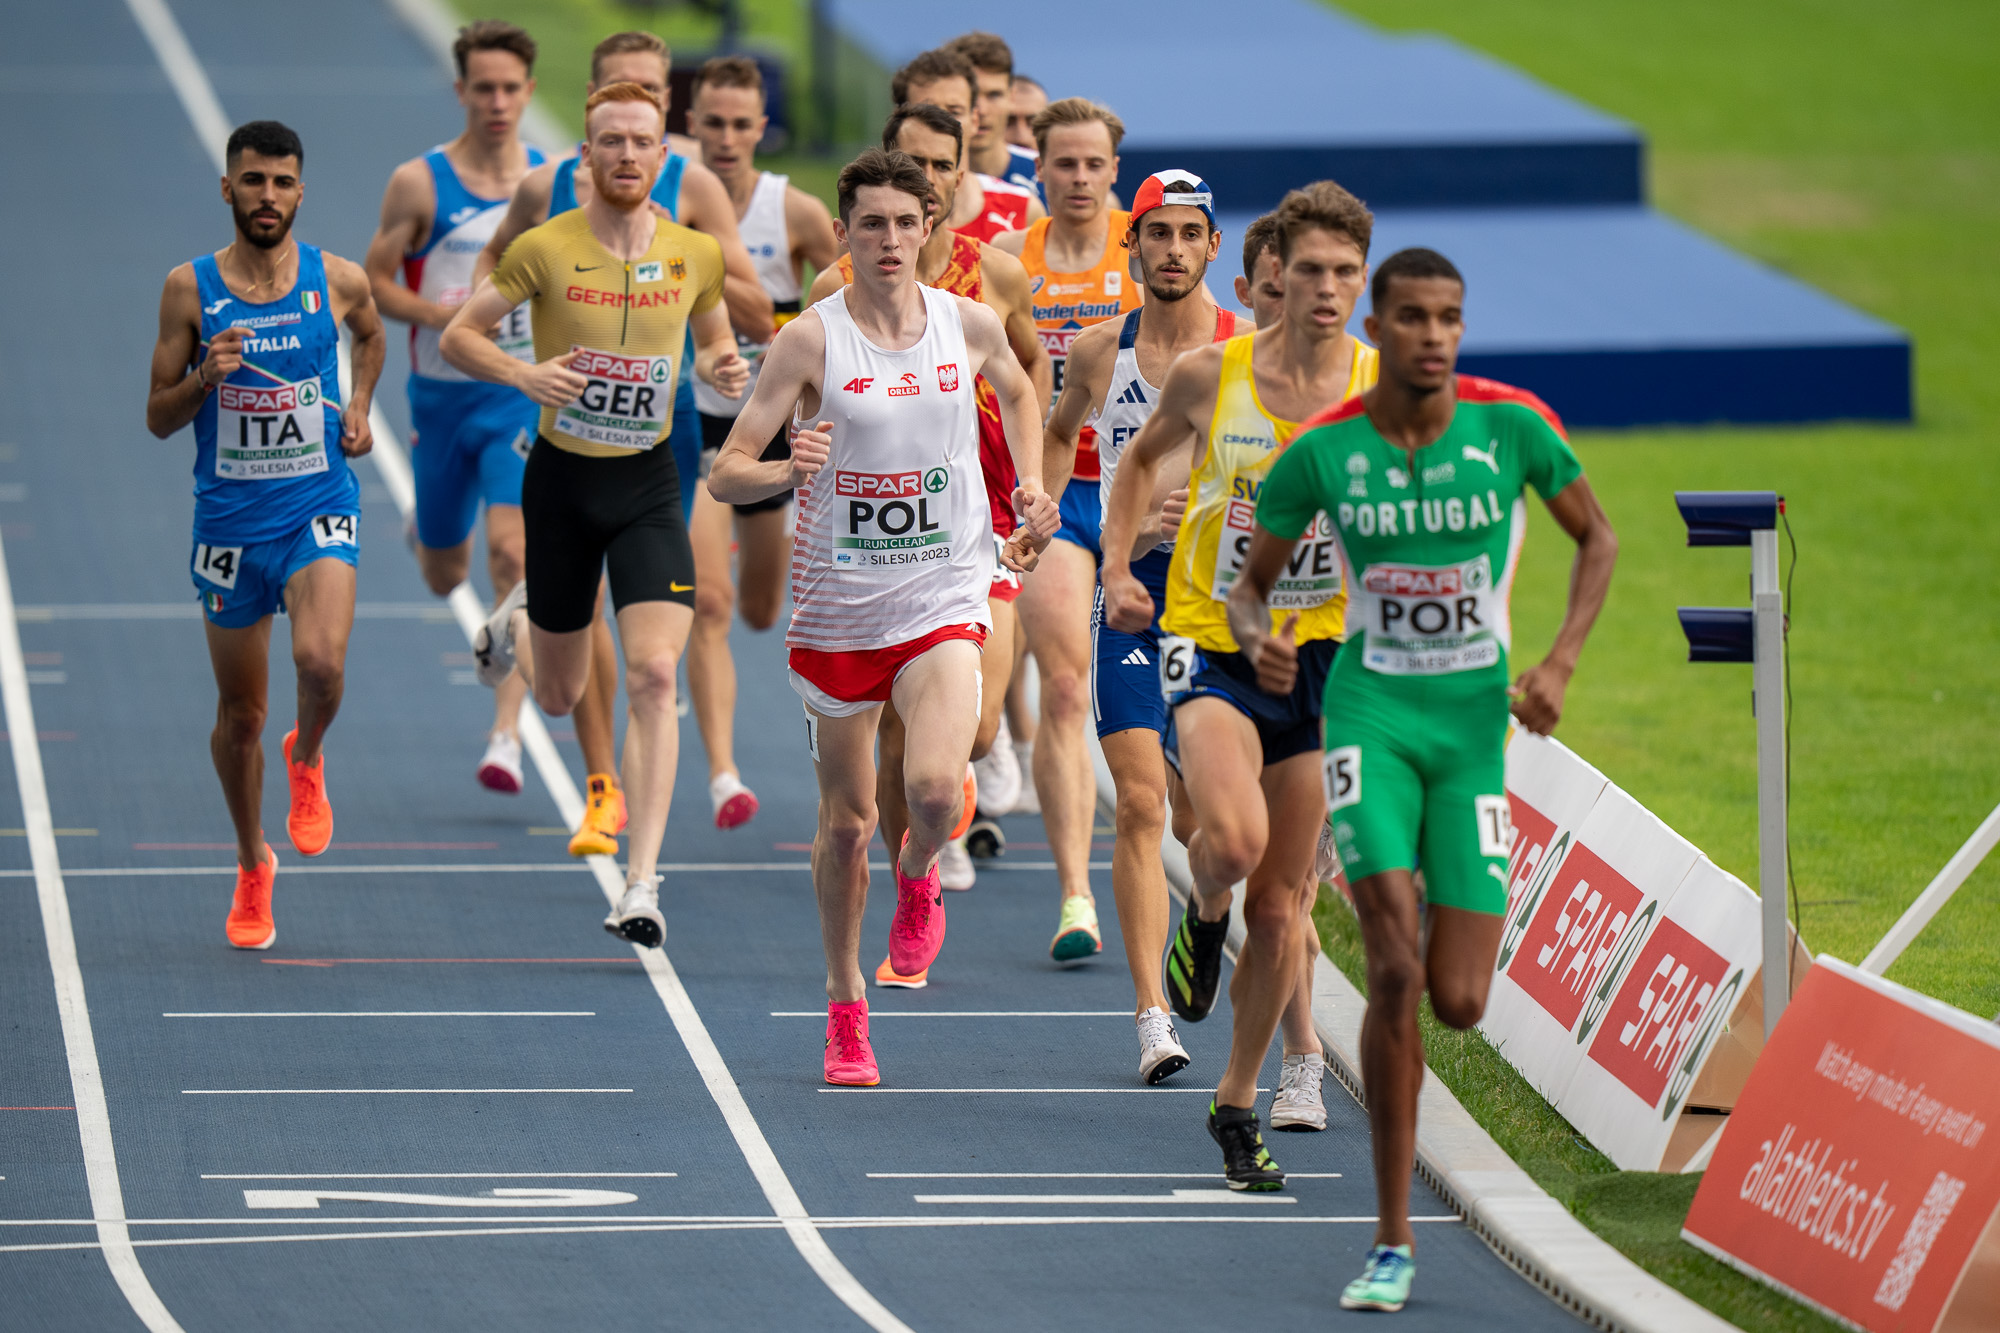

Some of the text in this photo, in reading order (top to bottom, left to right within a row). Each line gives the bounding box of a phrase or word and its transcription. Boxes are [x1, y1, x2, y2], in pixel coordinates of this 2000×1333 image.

[566, 286, 682, 309] GERMANY
[243, 335, 301, 354] ITALIA
[573, 352, 648, 381] SPAR
[222, 388, 295, 410] SPAR
[580, 380, 656, 418] GER
[843, 378, 874, 394] 4F
[889, 387, 918, 396] ORLEN
[240, 413, 305, 448] ITA
[588, 428, 657, 448] SILESIA 202
[1223, 434, 1264, 447] CRAFT
[250, 456, 324, 474] SILESIA 2023
[838, 474, 919, 496] SPAR
[315, 514, 354, 541] 14
[850, 497, 939, 535] POL
[1338, 489, 1505, 538] PORTUGAL
[864, 540, 888, 549] RUN
[871, 547, 950, 565] SILESIA 2023
[201, 545, 235, 580] 14
[1368, 570, 1458, 594] SPAR
[1381, 596, 1482, 635] POR
[1328, 758, 1353, 800] 15
[1537, 879, 1628, 1003] SPAR
[1619, 953, 1714, 1079] SPAR
[1815, 1040, 1855, 1083] Watch
[1843, 1061, 1875, 1102] every
[1898, 1082, 1926, 1116] of
[1909, 1094, 1943, 1136] every
[1935, 1106, 1976, 1143] event
[1962, 1119, 1987, 1148] on
[1739, 1122, 1896, 1264] allathletics.tv
